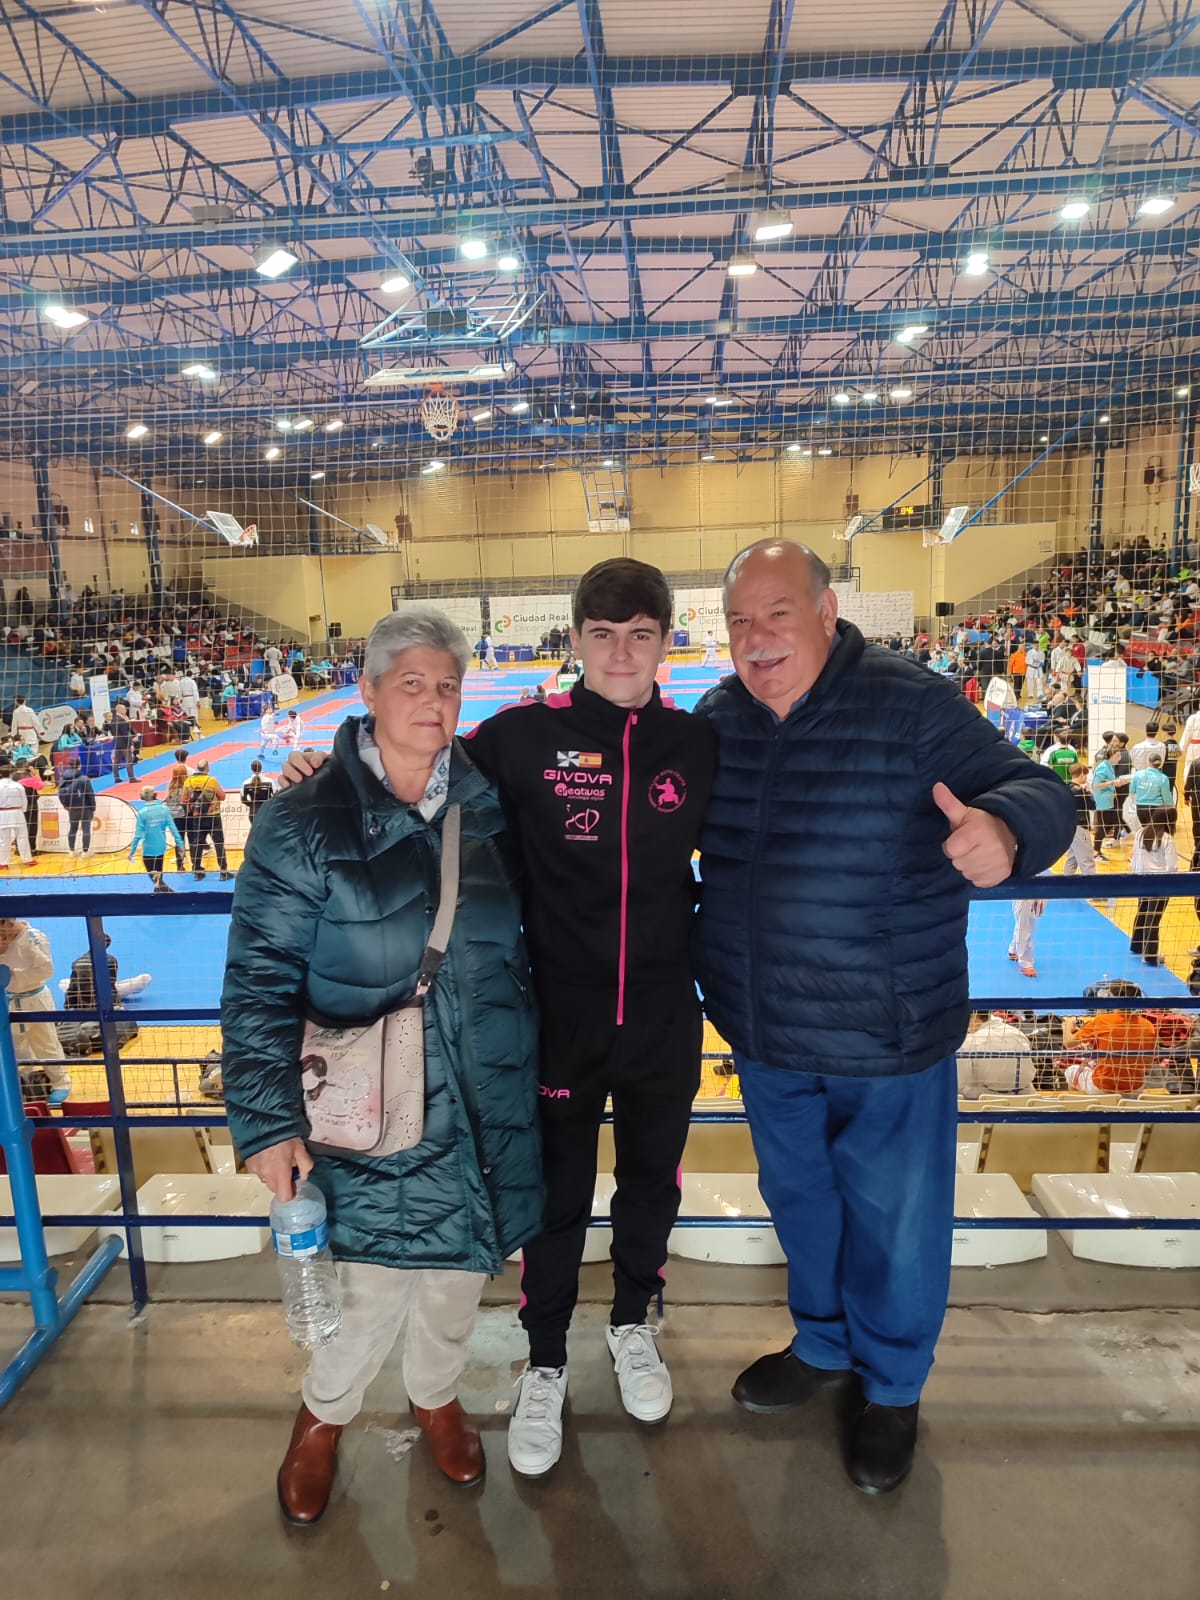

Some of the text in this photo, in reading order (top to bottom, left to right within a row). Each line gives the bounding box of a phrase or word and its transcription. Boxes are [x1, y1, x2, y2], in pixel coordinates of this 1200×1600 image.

[697, 606, 725, 615] Ciuda
[513, 612, 569, 623] Ciudad Real
[543, 769, 613, 785] GIVOVA
[220, 805, 243, 813] udad
[539, 1085, 570, 1099] OVA
